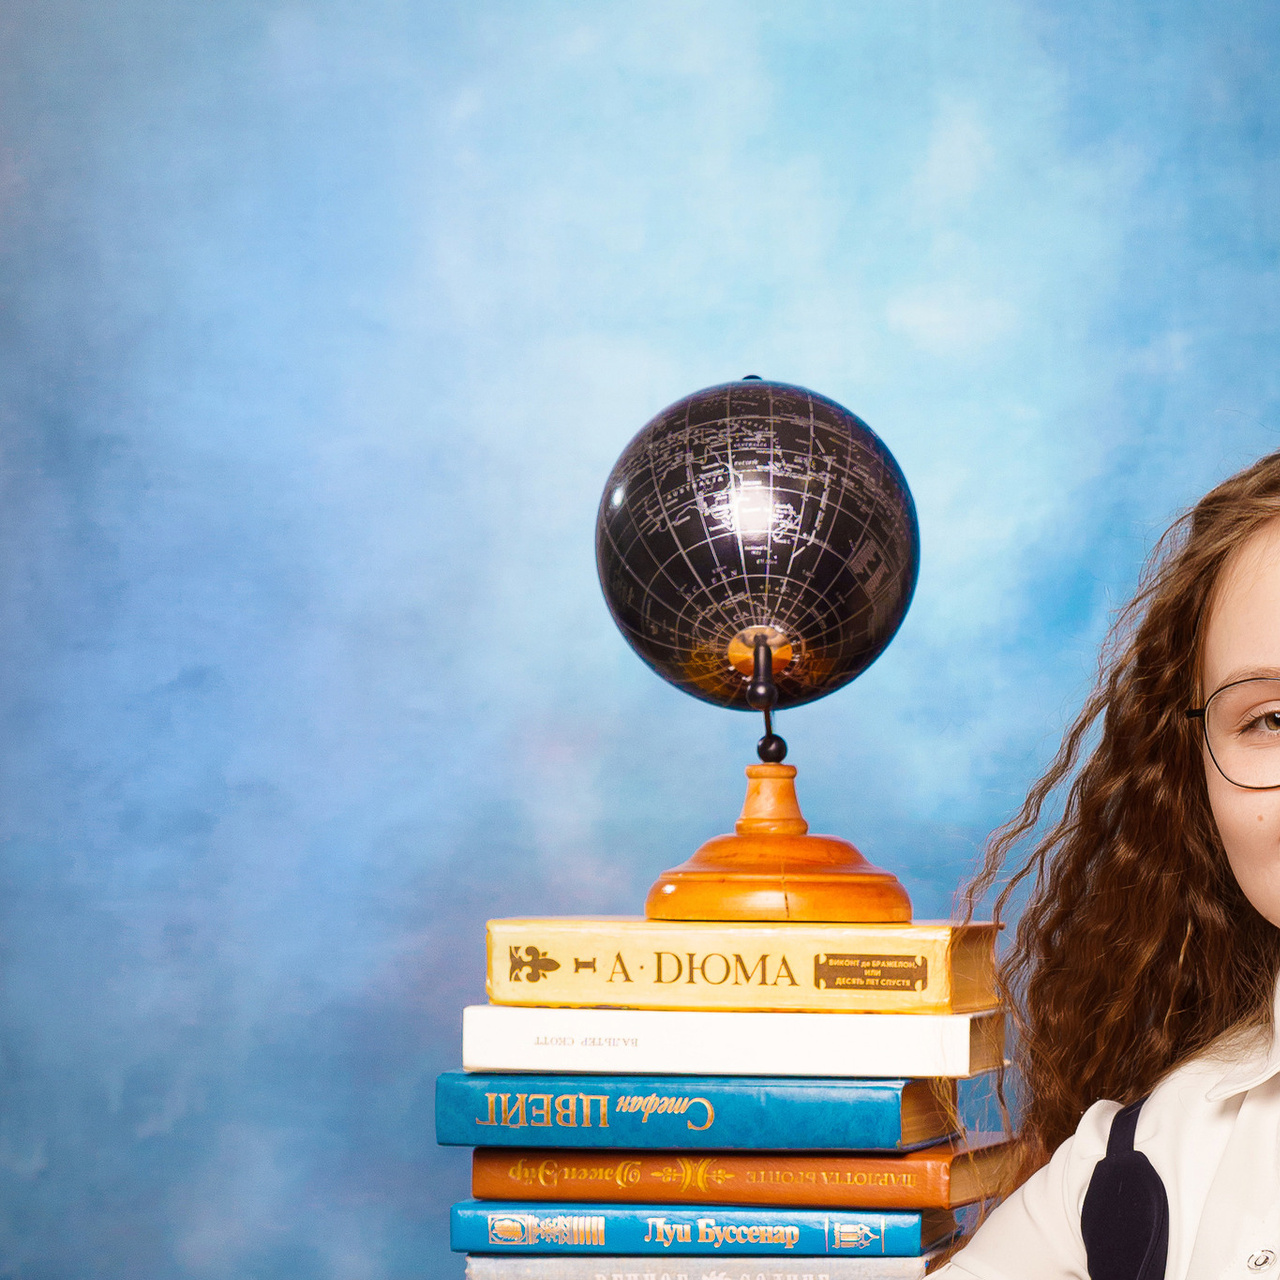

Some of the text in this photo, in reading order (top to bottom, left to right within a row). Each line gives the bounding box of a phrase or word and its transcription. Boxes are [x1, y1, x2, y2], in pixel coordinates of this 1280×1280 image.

[828, 959, 860, 967] ВИКОНТ
[835, 977, 865, 986] ДЕСЯТЬ
[880, 979, 911, 987] СПУСТЯ
[534, 1036, 638, 1047] ВАЛЬТЕР СКОТТ
[475, 1092, 715, 1130] Стефан ЦВЕЙГ
[508, 1158, 642, 1189] Джен Эйр
[746, 1170, 918, 1187] ШАРЛОТТА БРОНТЕ
[644, 1217, 800, 1249] Луи Буссенар
